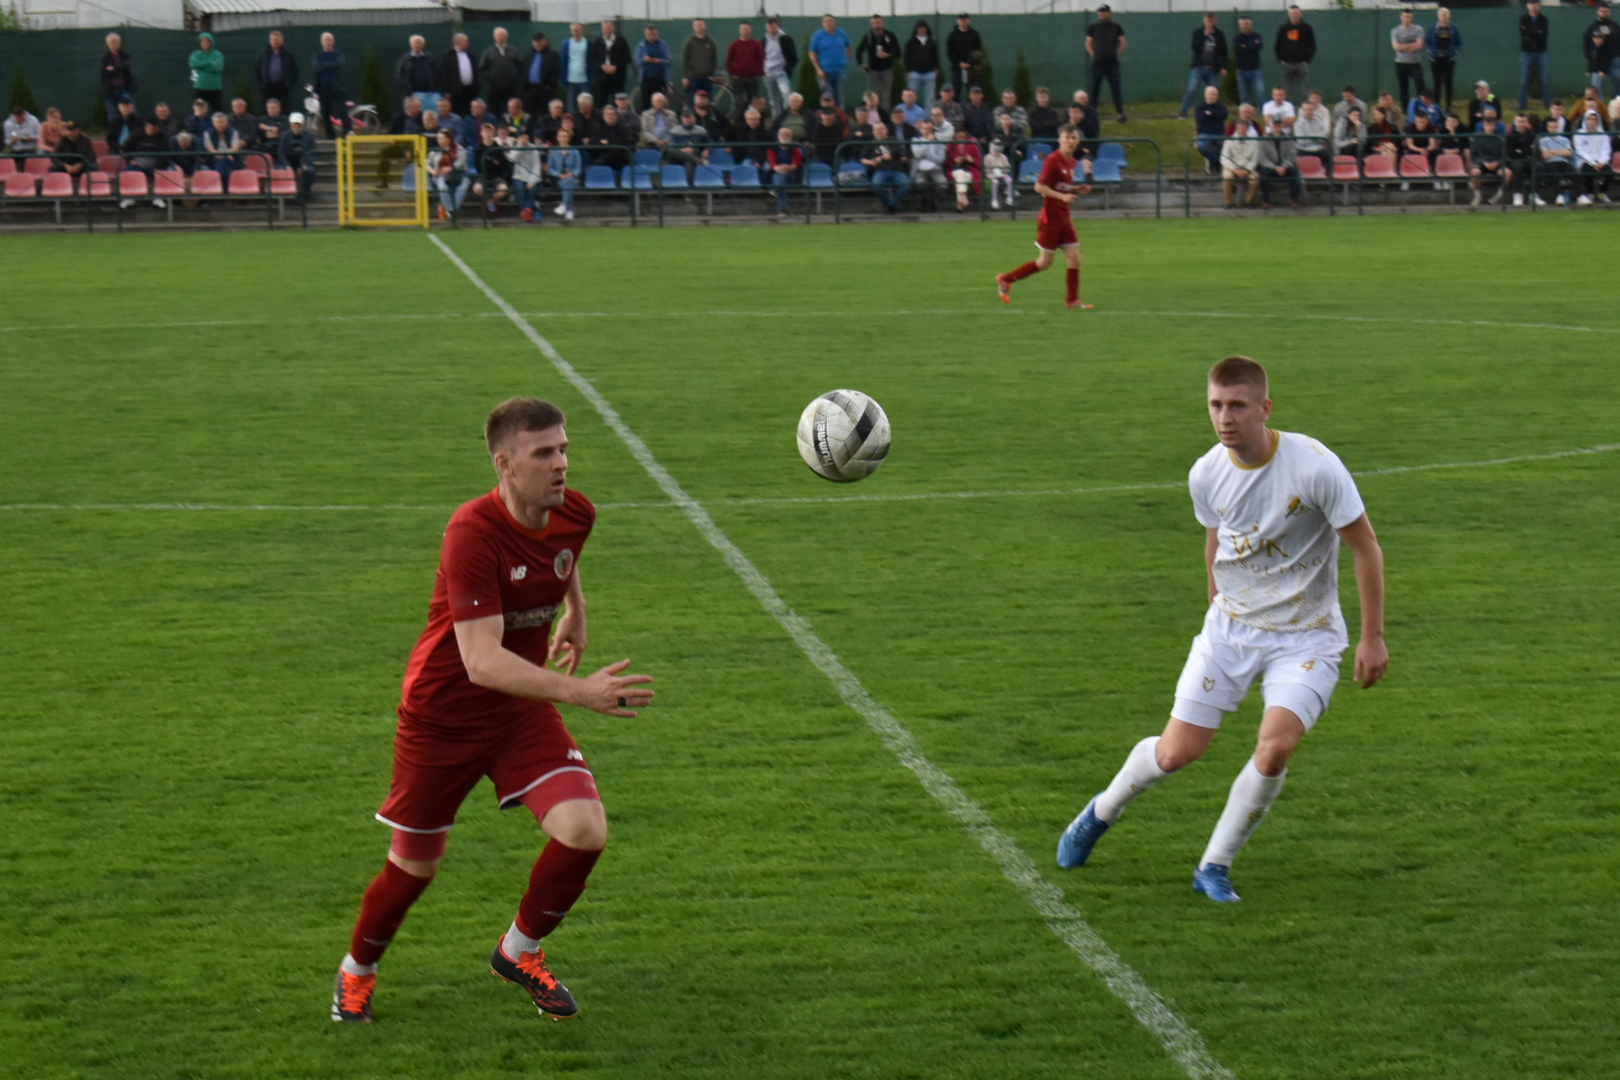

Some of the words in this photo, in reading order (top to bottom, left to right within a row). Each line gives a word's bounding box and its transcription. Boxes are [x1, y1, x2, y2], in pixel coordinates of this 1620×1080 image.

[815, 420, 834, 466] hummel
[510, 565, 527, 581] NB
[1301, 659, 1316, 671] 4
